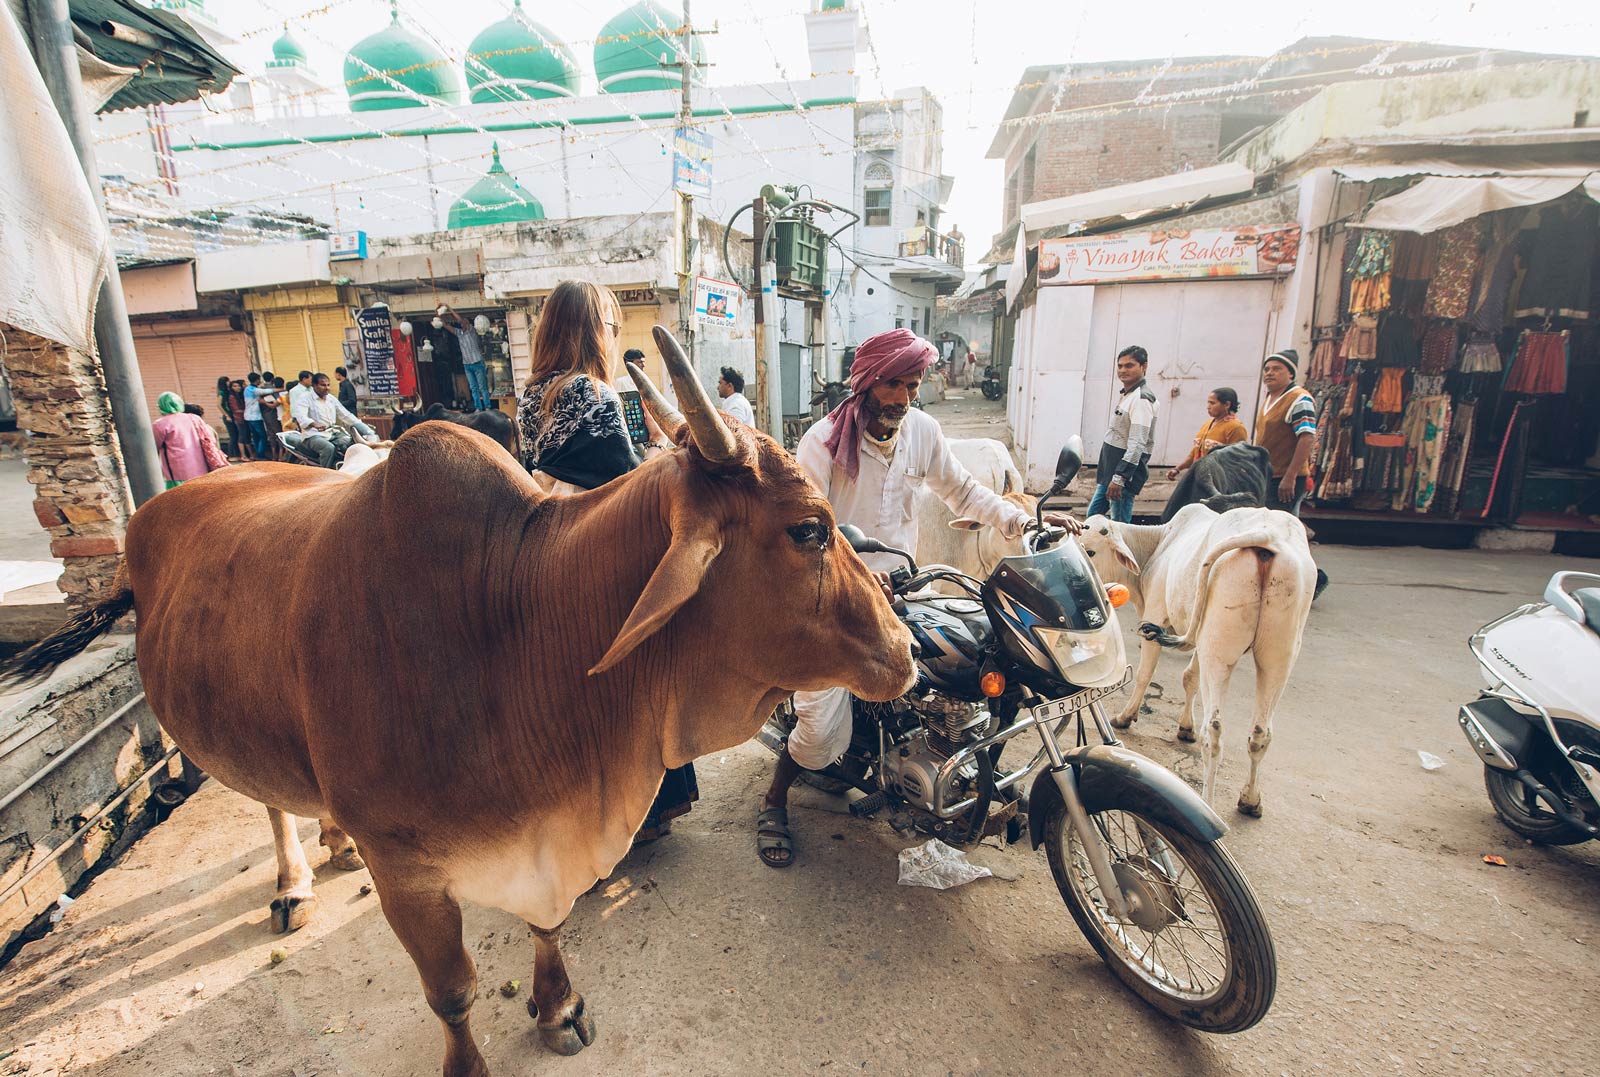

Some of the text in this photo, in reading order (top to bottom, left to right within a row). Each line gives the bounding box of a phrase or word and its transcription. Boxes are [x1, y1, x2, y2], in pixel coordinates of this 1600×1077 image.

[1082, 236, 1247, 272] Vinayak Bakers
[359, 317, 389, 328] Sunita
[363, 327, 385, 338] Craft
[365, 339, 388, 350] India
